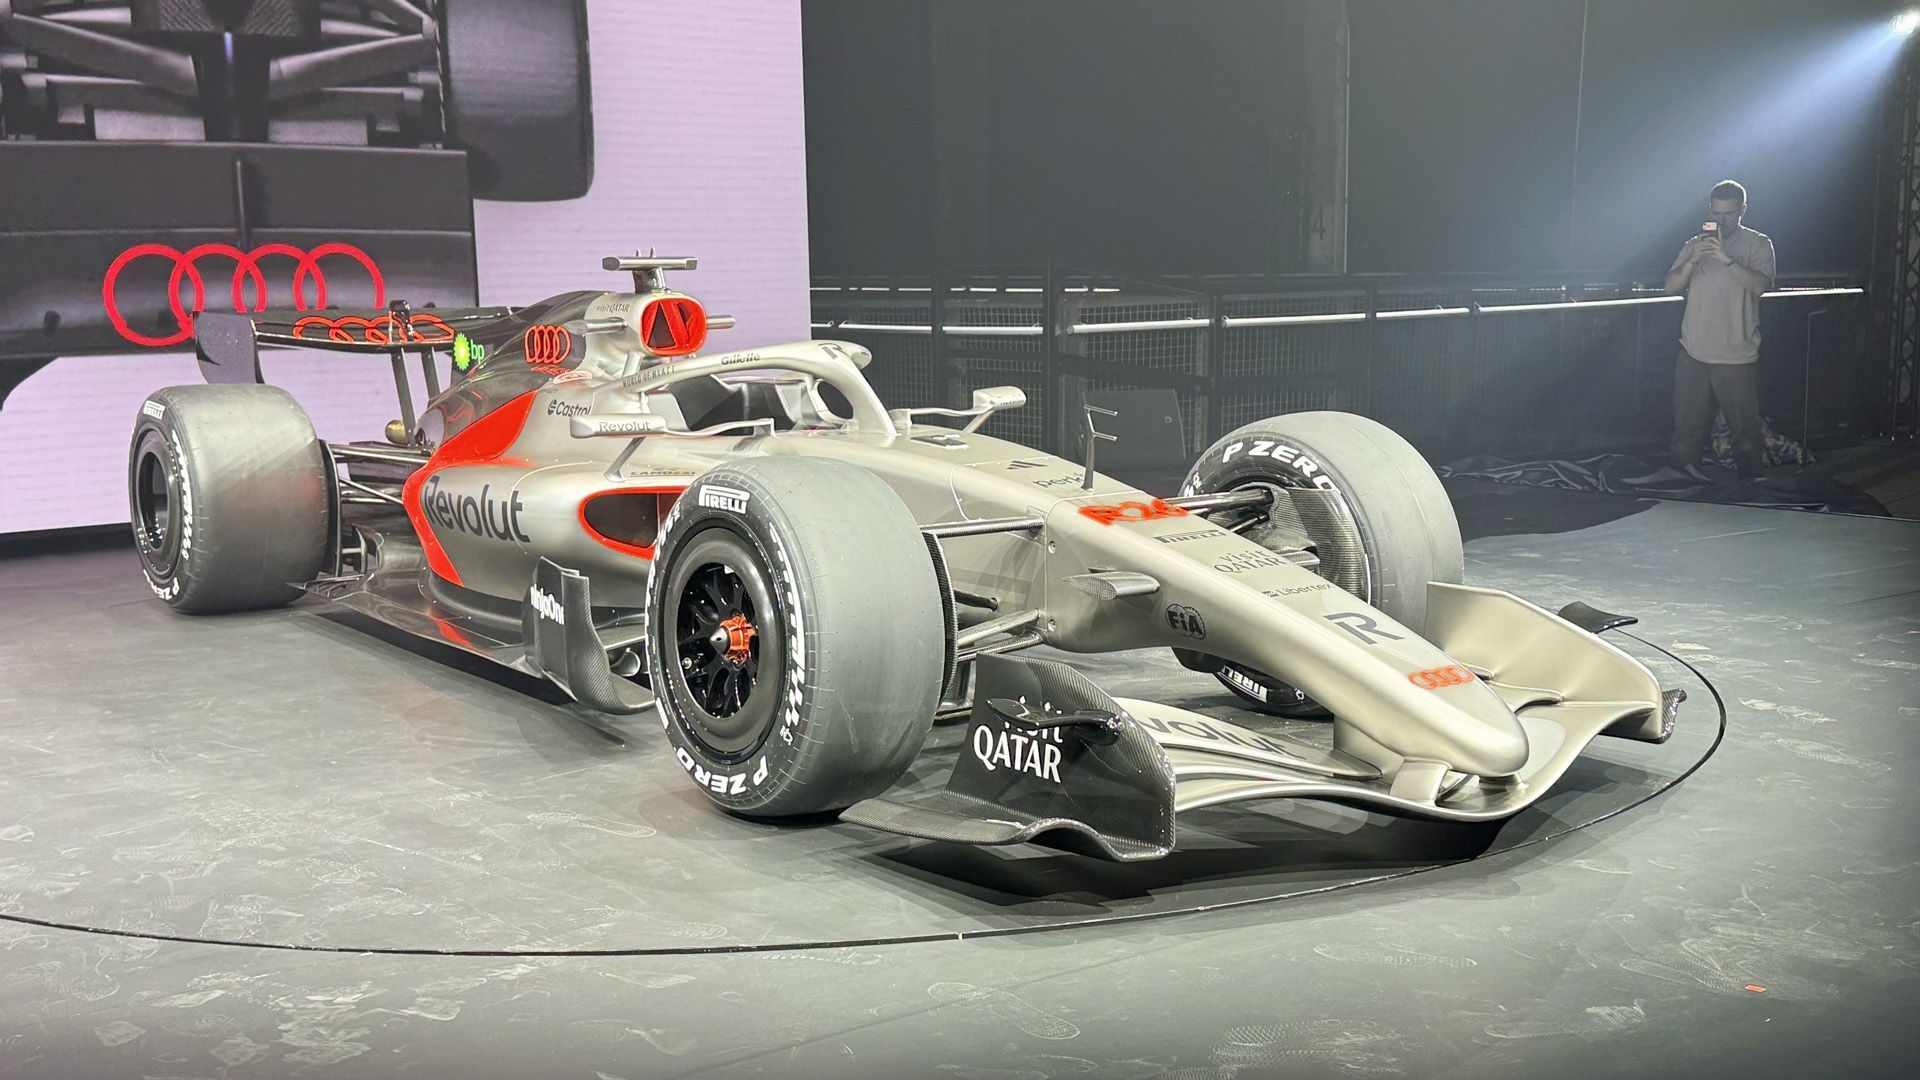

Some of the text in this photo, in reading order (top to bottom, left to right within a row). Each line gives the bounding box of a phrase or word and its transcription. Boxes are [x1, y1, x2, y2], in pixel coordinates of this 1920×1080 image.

[470, 339, 485, 364] bp
[555, 400, 592, 417] Castrol
[600, 421, 651, 432] Revolut
[1222, 440, 1342, 494] P ZERO
[424, 475, 531, 543] Revolut
[698, 484, 751, 515] PIRELLI
[1153, 529, 1227, 544] PIRELLI
[1213, 556, 1287, 574] QATAR
[1219, 549, 1269, 563] visit
[1277, 582, 1333, 597] Libertex
[1323, 612, 1406, 646] R
[973, 724, 1062, 783] QATAR
[676, 746, 769, 795] P ZERO
